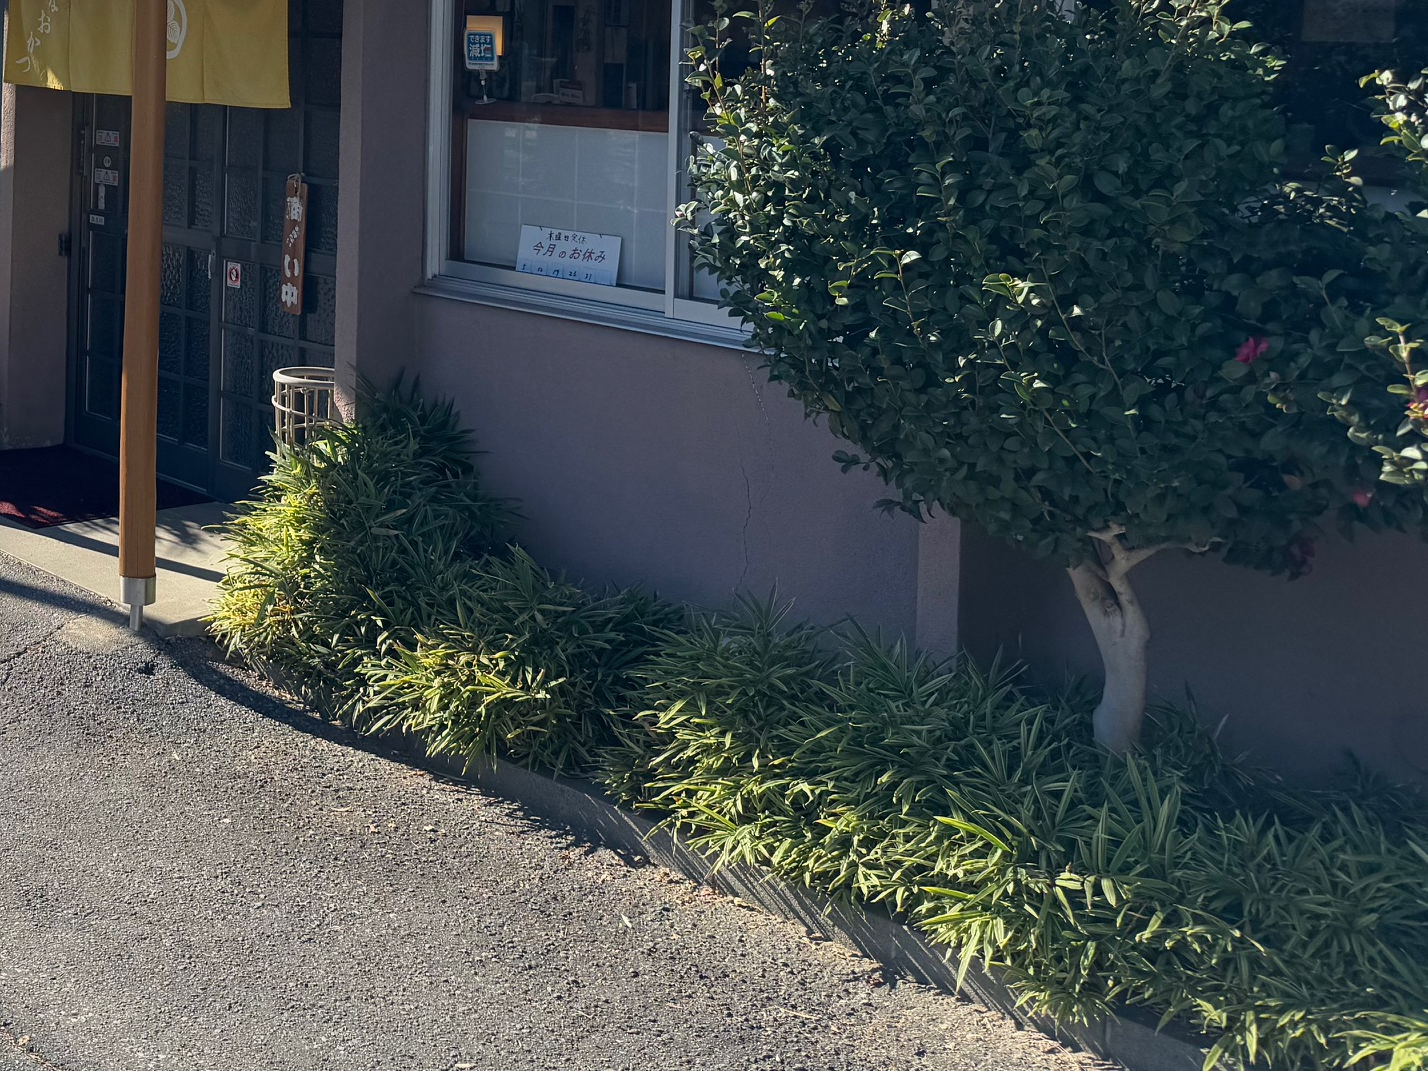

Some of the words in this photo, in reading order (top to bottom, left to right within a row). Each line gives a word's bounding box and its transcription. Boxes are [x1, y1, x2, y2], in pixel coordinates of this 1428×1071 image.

[532, 241, 606, 263] 今月のお休み
